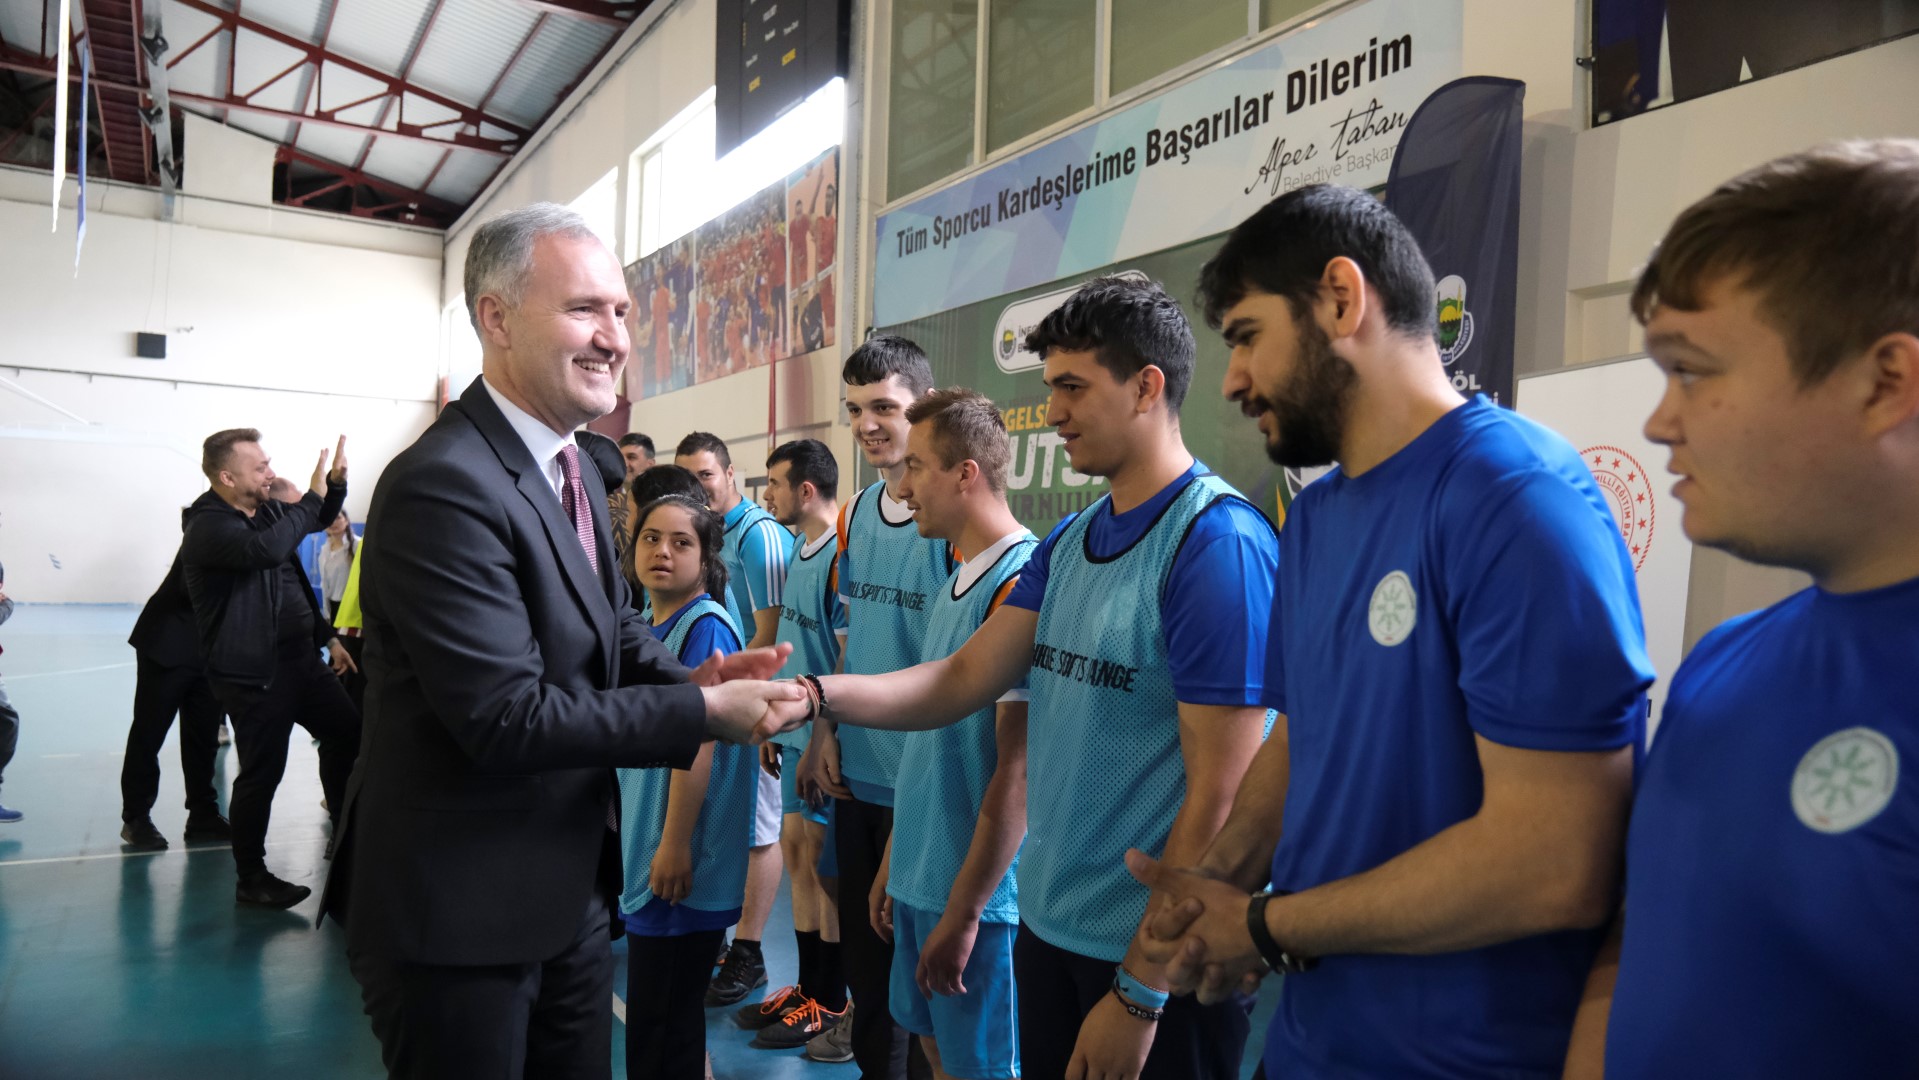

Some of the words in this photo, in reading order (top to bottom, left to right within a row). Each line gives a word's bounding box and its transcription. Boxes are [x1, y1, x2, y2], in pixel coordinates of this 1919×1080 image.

[897, 226, 927, 258] Tüm
[933, 203, 991, 249] Sporcu
[998, 146, 1136, 222] Kardeşlerime
[1145, 90, 1274, 168] Başarılar
[1286, 34, 1412, 115] Dilerim
[1284, 163, 1342, 193] Belediye
[1447, 370, 1481, 391] ÖL
